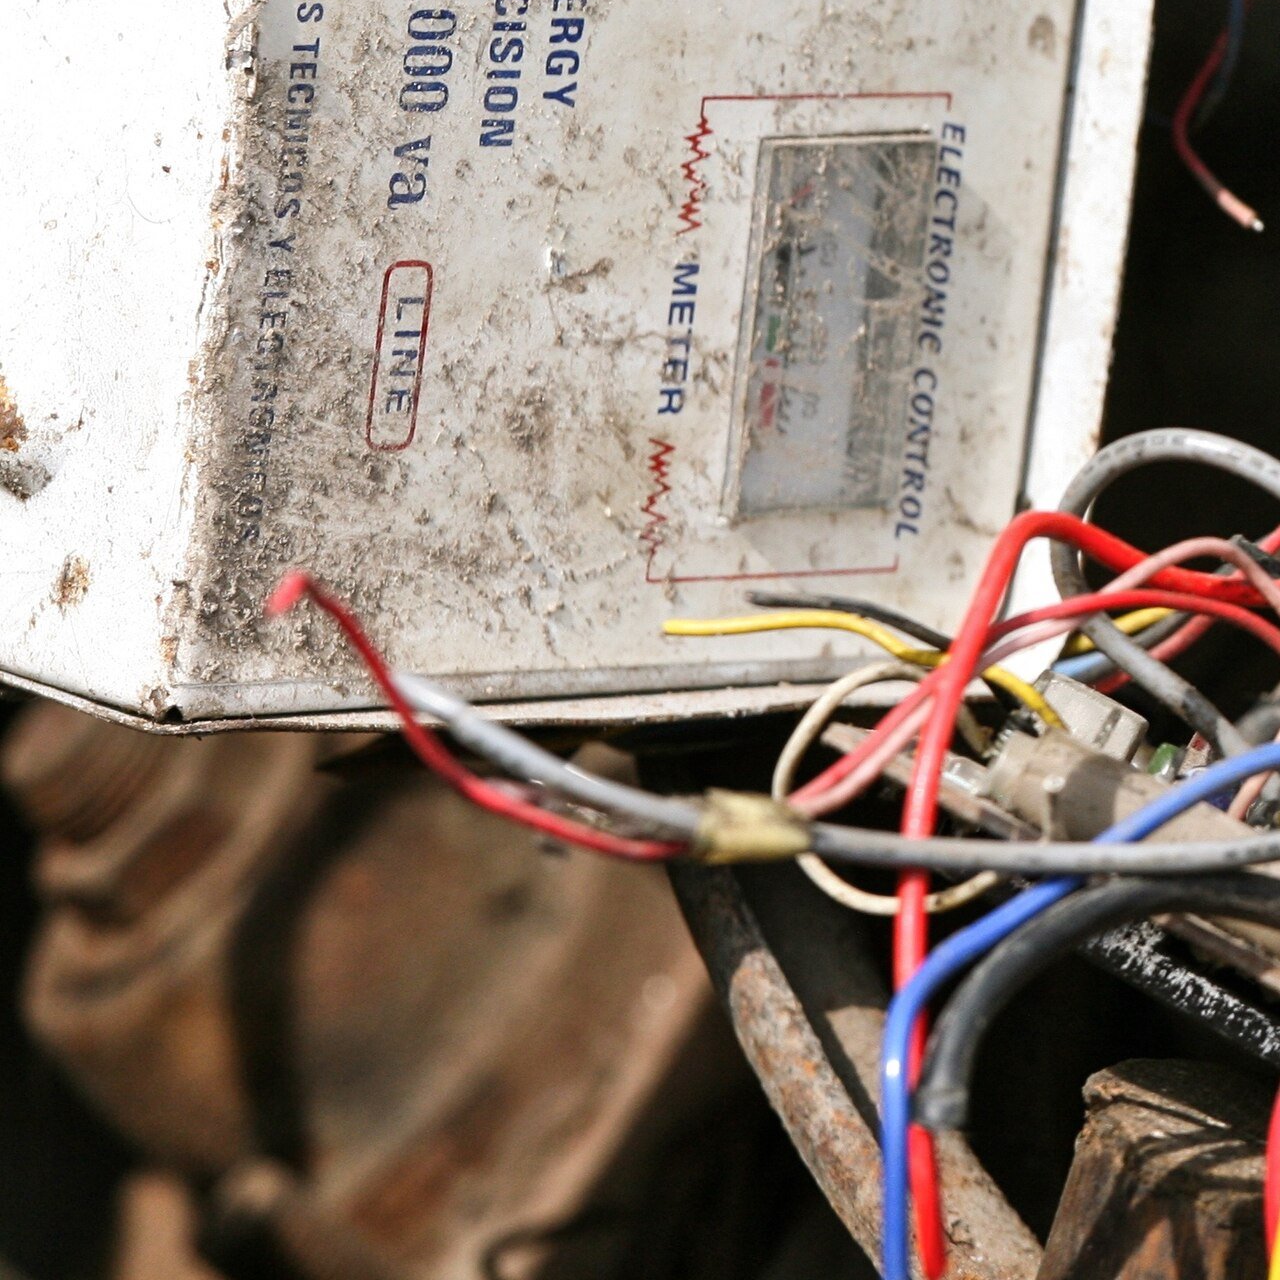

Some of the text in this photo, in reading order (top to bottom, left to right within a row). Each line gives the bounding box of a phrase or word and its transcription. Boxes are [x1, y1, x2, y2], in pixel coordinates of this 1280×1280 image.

[273, 36, 322, 220] TECNICOS
[388, 135, 432, 210] va
[268, 234, 297, 254] Y
[385, 296, 425, 415] LINE
[660, 264, 699, 413] METER
[895, 121, 967, 541] ELECTRONIC CONTROL
